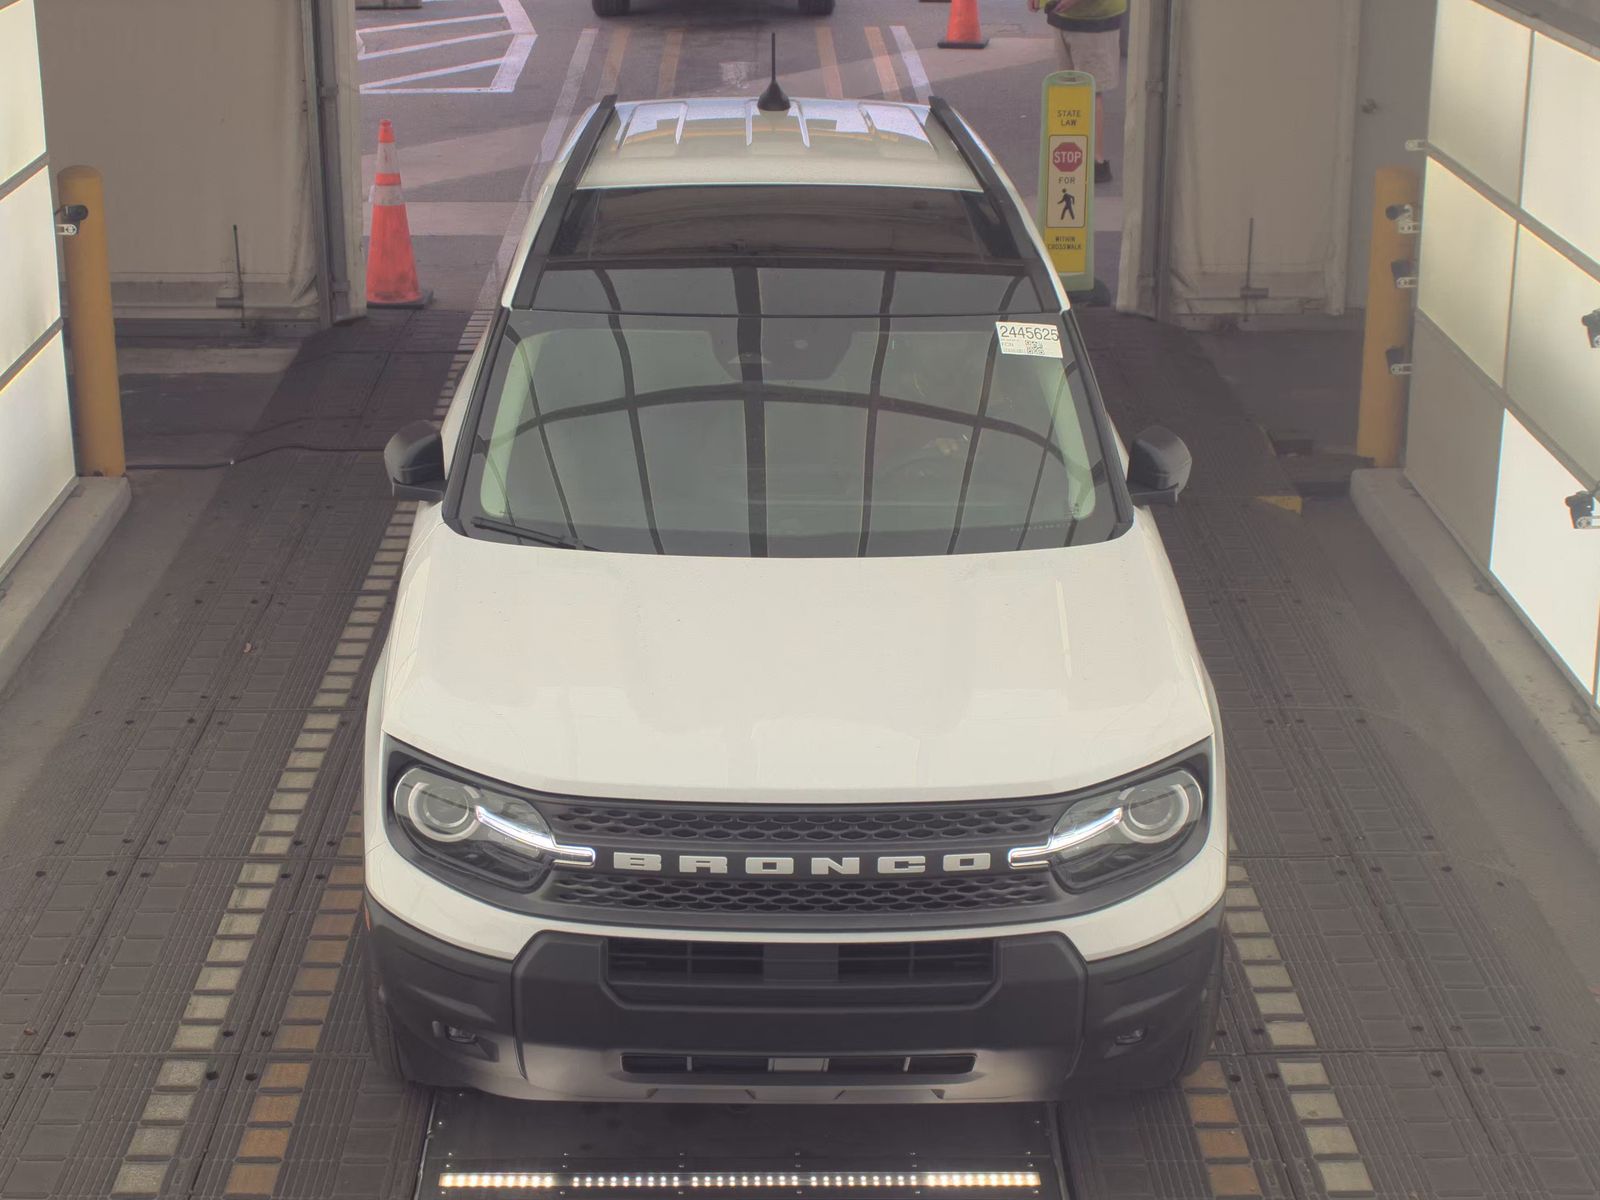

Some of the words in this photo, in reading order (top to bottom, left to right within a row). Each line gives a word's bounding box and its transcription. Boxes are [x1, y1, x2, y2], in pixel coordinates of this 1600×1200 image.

[1057, 109, 1081, 118] STATE
[1060, 119, 1077, 127] LAW
[1054, 151, 1081, 164] STOP
[1058, 176, 1076, 185] FOR
[1000, 325, 1059, 341] 2445625
[613, 851, 992, 875] BRONCO
